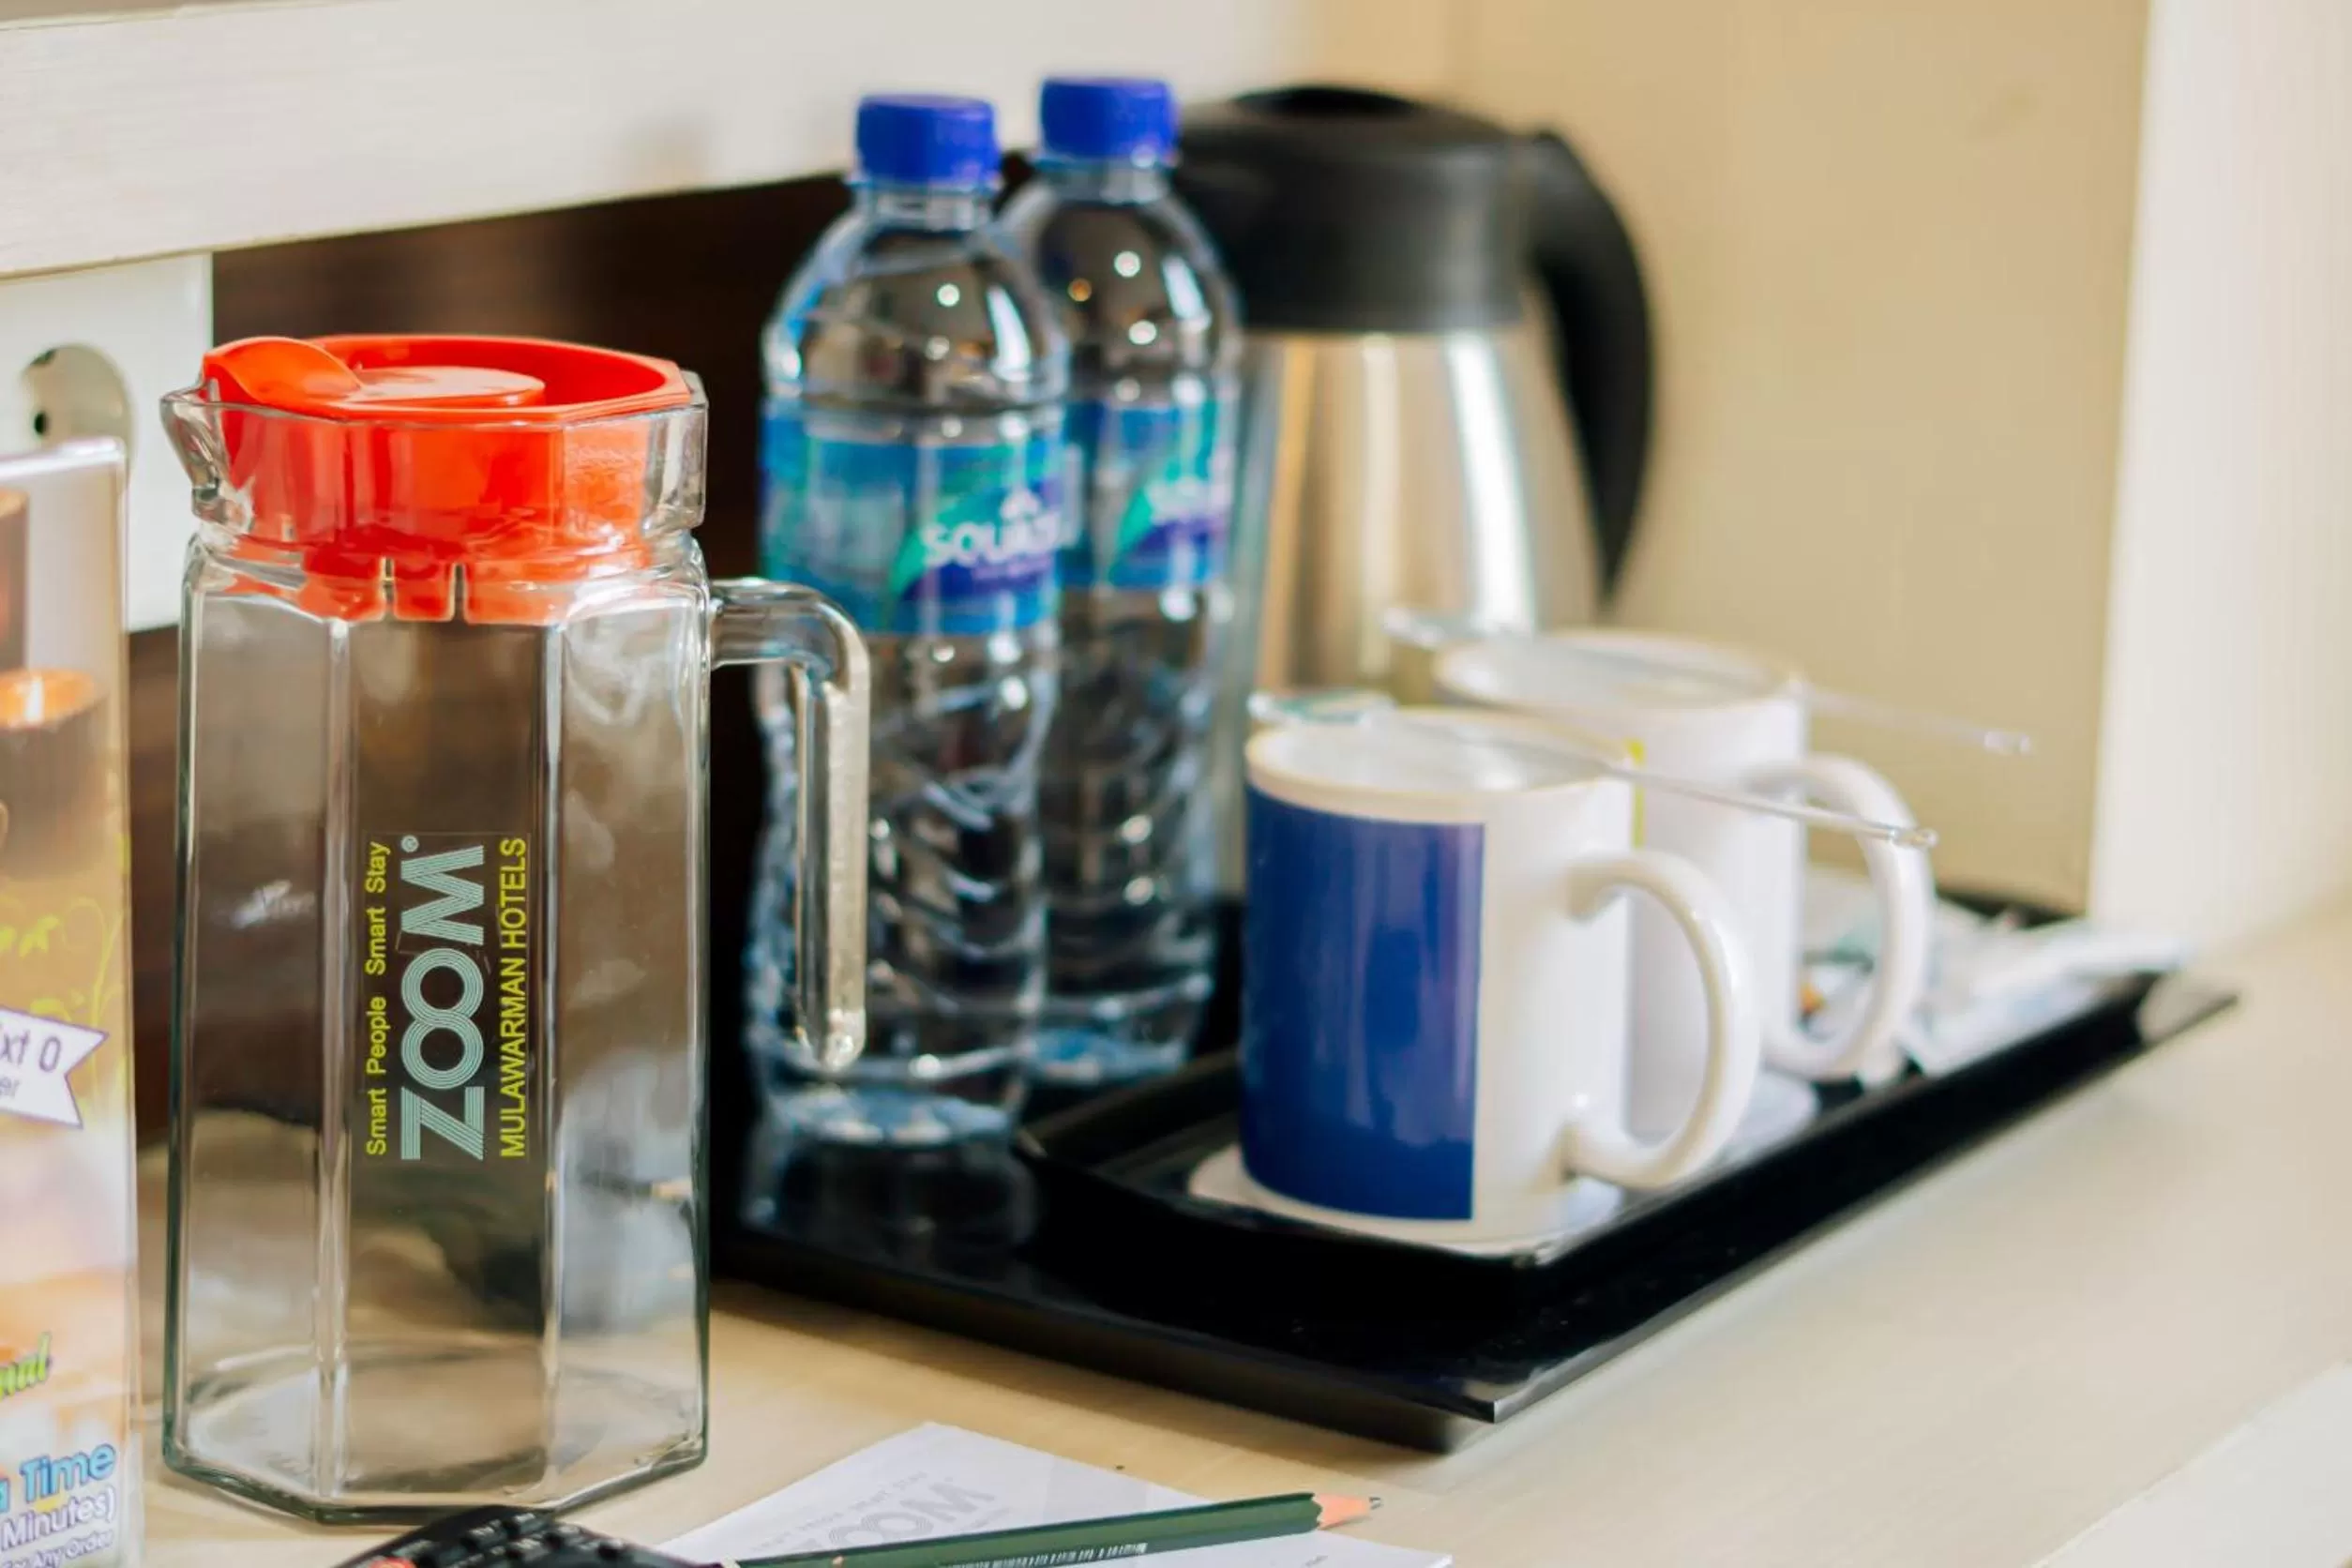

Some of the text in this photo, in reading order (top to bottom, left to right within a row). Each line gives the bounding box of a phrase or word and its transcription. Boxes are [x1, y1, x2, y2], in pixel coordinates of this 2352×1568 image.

[365, 841, 391, 1156] Smart People Smart Stay
[400, 843, 485, 1161] ZOOM
[499, 837, 527, 1158] MULAWARMAN HOTELS
[1, 1485, 116, 1551] Minutes)
[19, 1443, 117, 1502] Time
